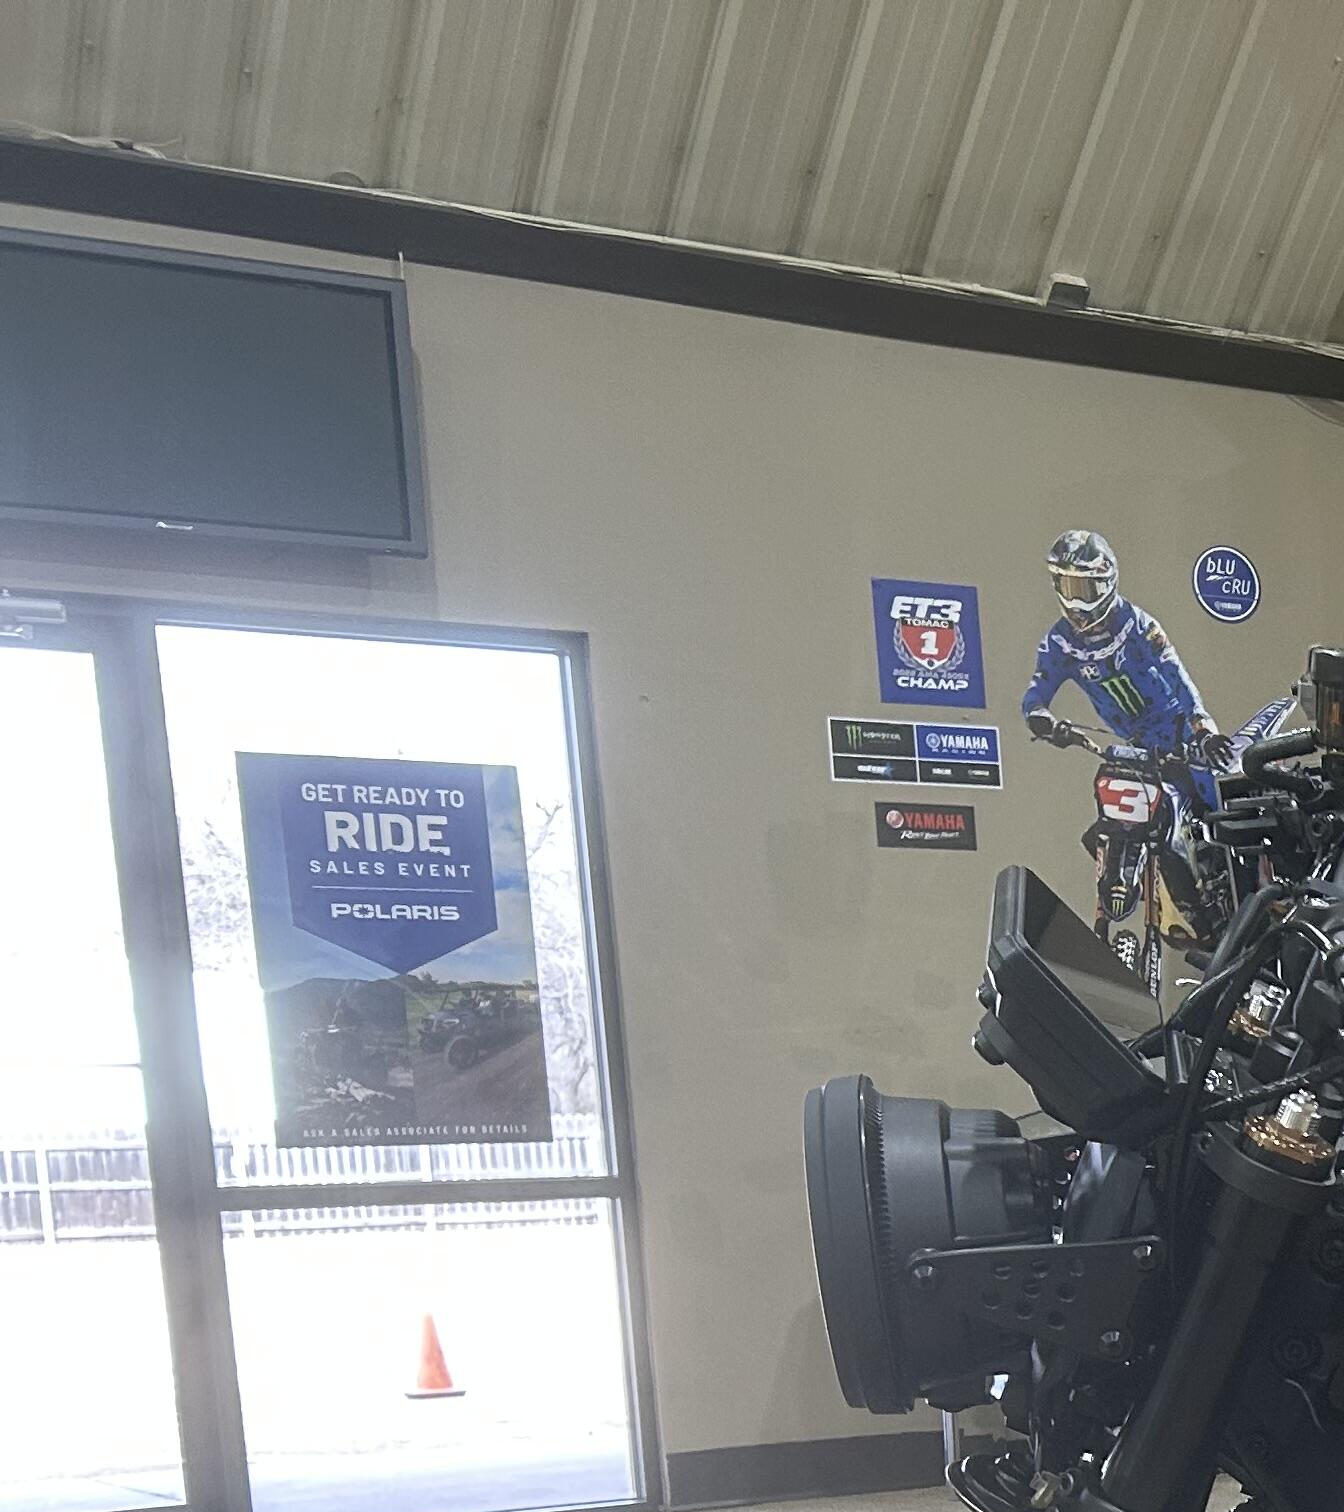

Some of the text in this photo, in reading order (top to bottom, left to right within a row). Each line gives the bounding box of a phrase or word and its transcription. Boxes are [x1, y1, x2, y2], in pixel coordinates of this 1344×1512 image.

[890, 595, 962, 622] ET3
[904, 618, 950, 629] TOMAC
[920, 630, 939, 655] 1
[897, 676, 969, 690] CHAMP
[940, 734, 989, 750] YAMAHA
[301, 783, 465, 809] GET READY TO
[1102, 779, 1158, 823] 3
[903, 812, 966, 830] YAMAHA
[323, 811, 451, 856] RIDE
[310, 859, 472, 879] SALES EVENT
[331, 902, 460, 921] POLARIS
[343, 1127, 381, 1137] SALES
[482, 1124, 528, 1135] DETAILS
